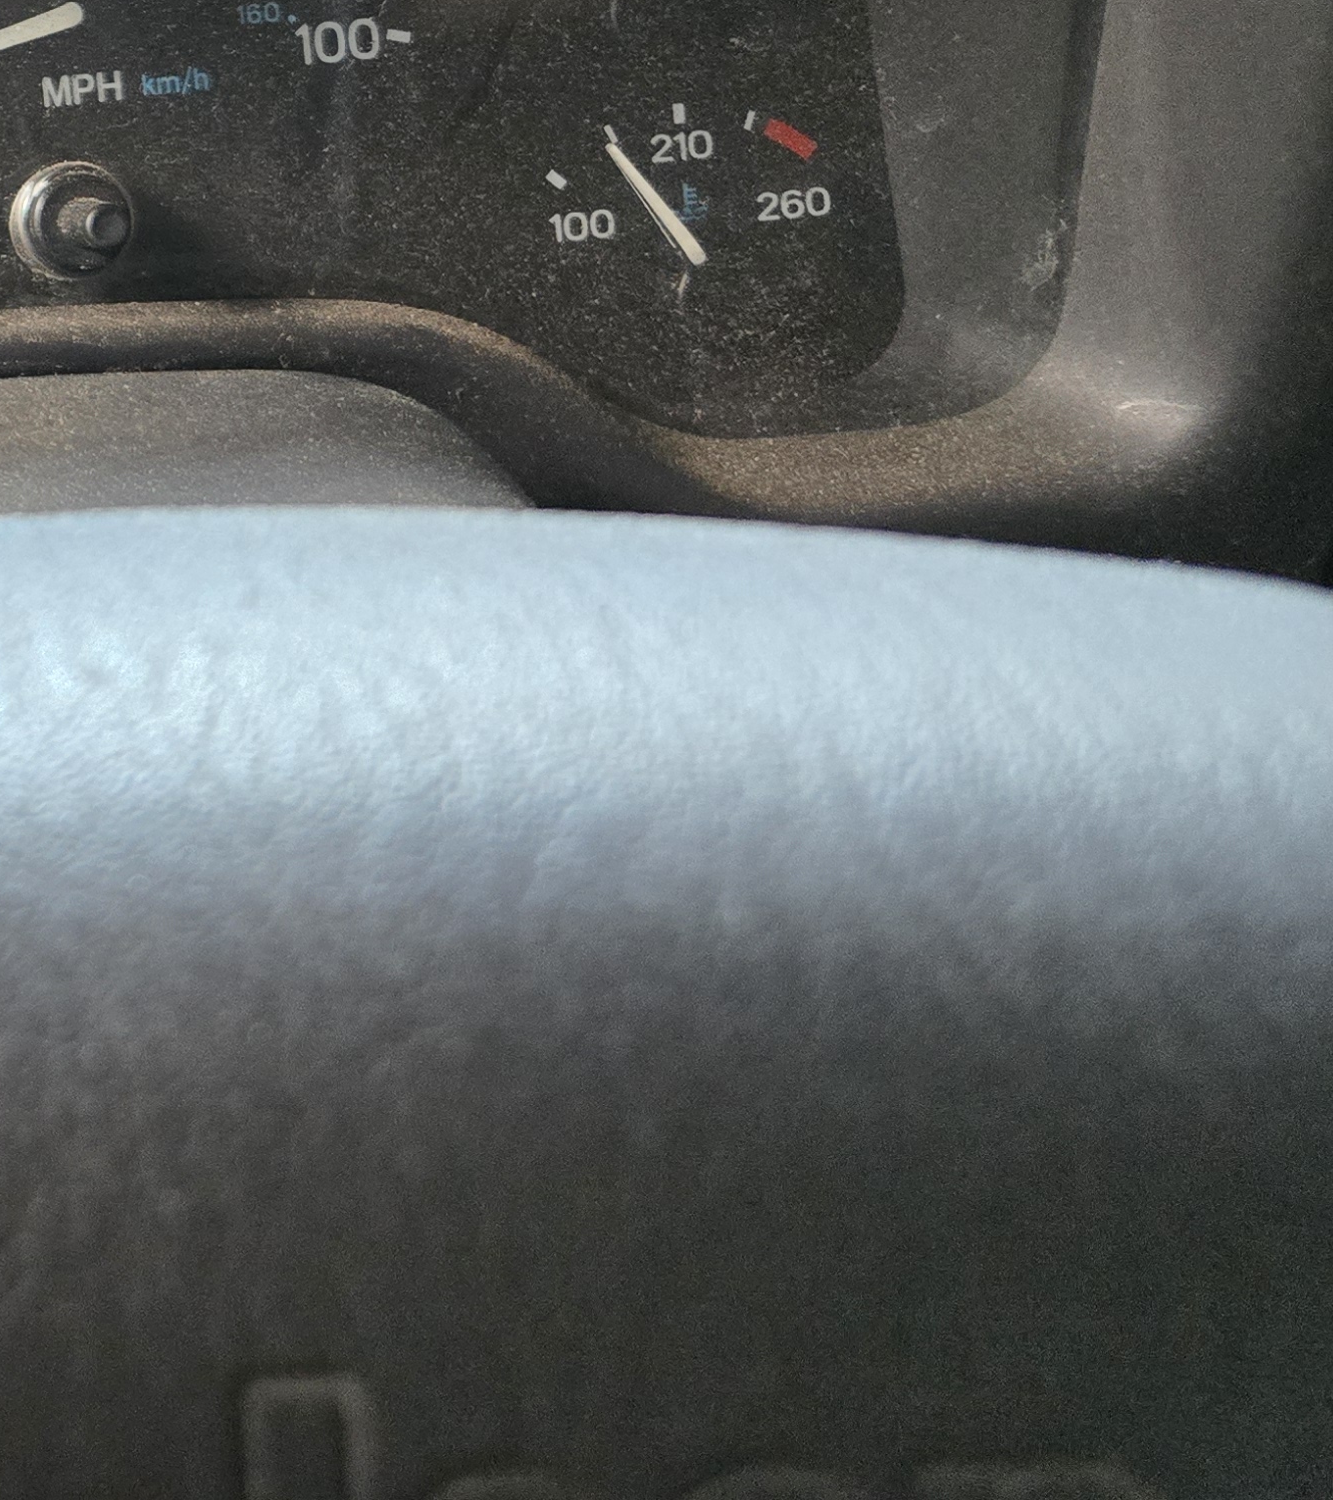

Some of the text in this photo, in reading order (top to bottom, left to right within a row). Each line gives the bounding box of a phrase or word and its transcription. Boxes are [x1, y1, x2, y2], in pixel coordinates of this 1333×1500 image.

[239, 2, 280, 25] 160
[295, 18, 380, 65] 100
[42, 67, 210, 107] MPH km/h
[651, 130, 713, 163] 210
[756, 187, 831, 220] 260
[548, 209, 615, 242] 100
